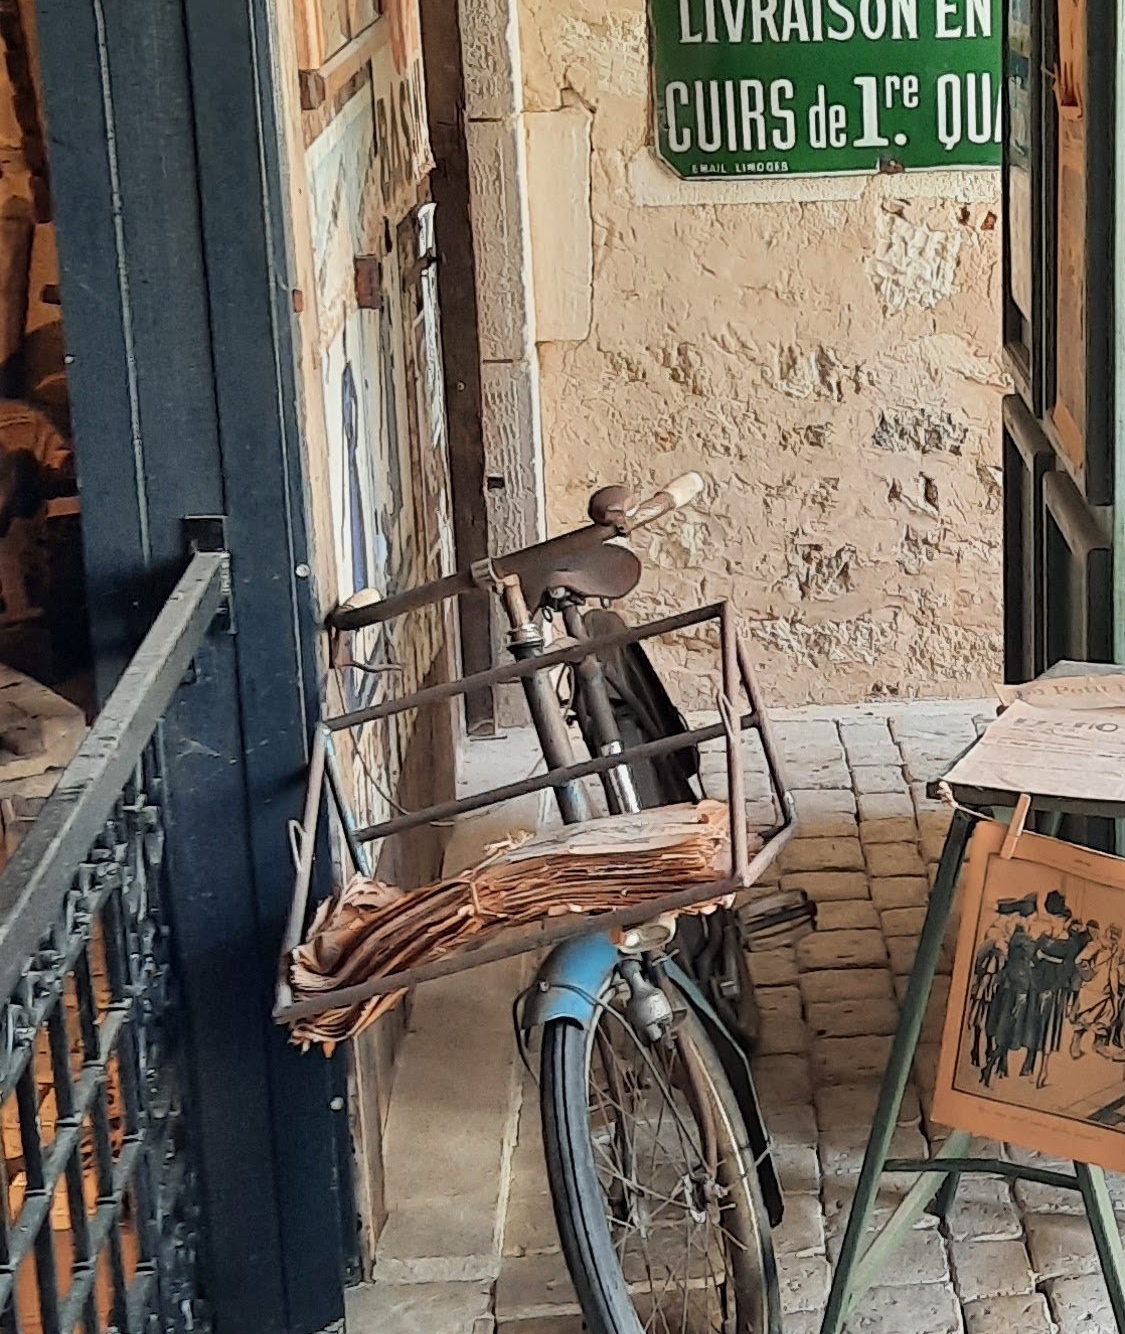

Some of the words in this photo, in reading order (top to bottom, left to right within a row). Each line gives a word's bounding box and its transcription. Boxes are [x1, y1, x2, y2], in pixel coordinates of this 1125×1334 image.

[664, 77, 797, 155] CUIRS
[807, 83, 846, 150] de
[1053, 684, 1110, 695] Petit
